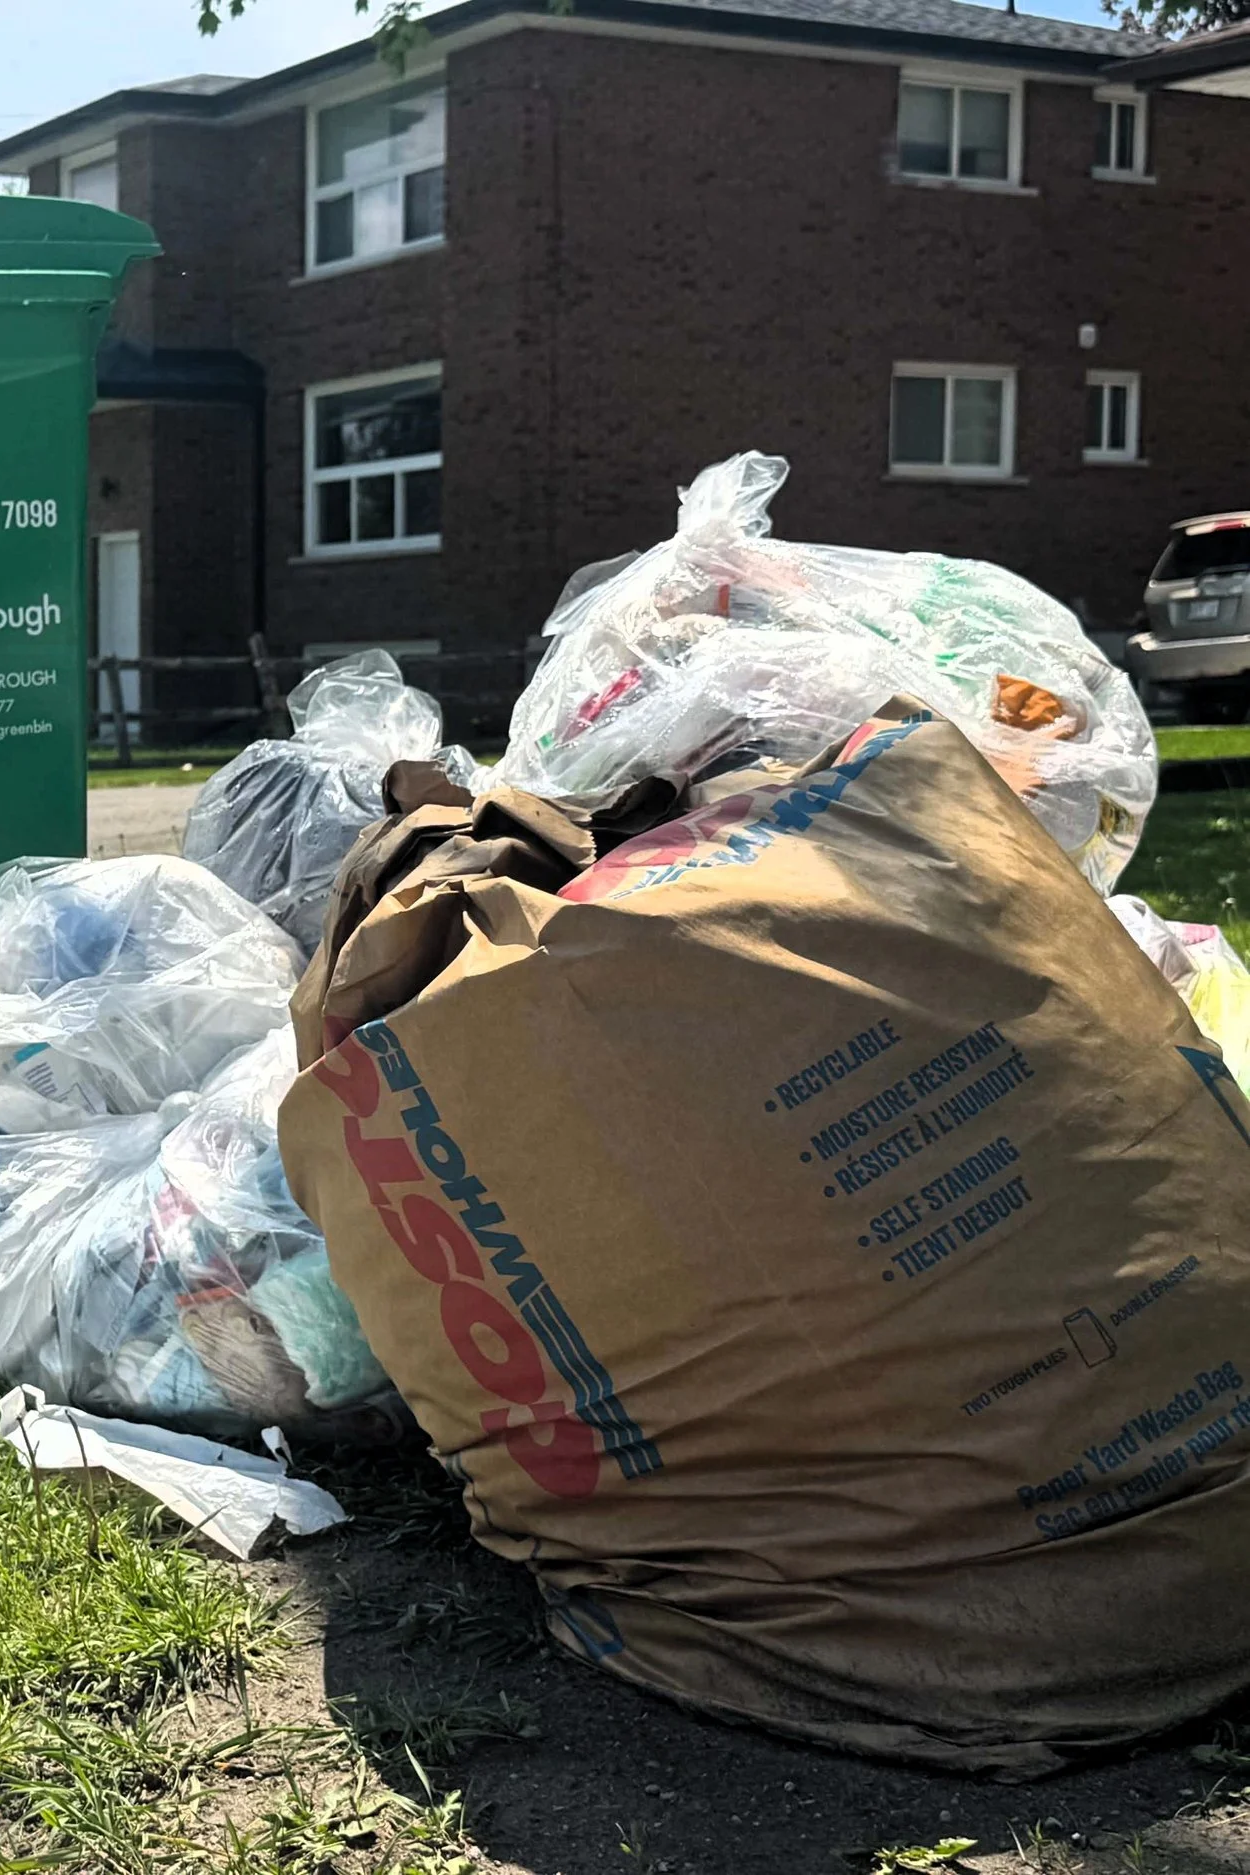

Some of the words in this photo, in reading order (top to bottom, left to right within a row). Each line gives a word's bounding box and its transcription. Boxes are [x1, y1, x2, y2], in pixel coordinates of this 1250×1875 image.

[774, 1017, 902, 1110] RECYCLABLE
[809, 1080, 918, 1161] MOISTURE
[907, 1020, 1007, 1100] RESISTANT
[833, 1126, 923, 1196] RÉSISTE
[912, 1113, 940, 1146] À
[930, 1046, 1036, 1135] L'HUMIDITÉ
[353, 1018, 546, 1306] WHOLES
[869, 1195, 924, 1244] SELF
[920, 1136, 1021, 1212] STANDING
[311, 1016, 600, 1499] COSTC
[890, 1223, 959, 1279] TIENT
[951, 1174, 1033, 1243] DEBOUT
[960, 1391, 992, 1417] TWO
[990, 1366, 1038, 1400] TOUGH
[1032, 1347, 1069, 1376] PLIES
[1083, 1423, 1142, 1475] Yard
[1132, 1388, 1204, 1443] Waste
[1193, 1360, 1245, 1400] Bag
